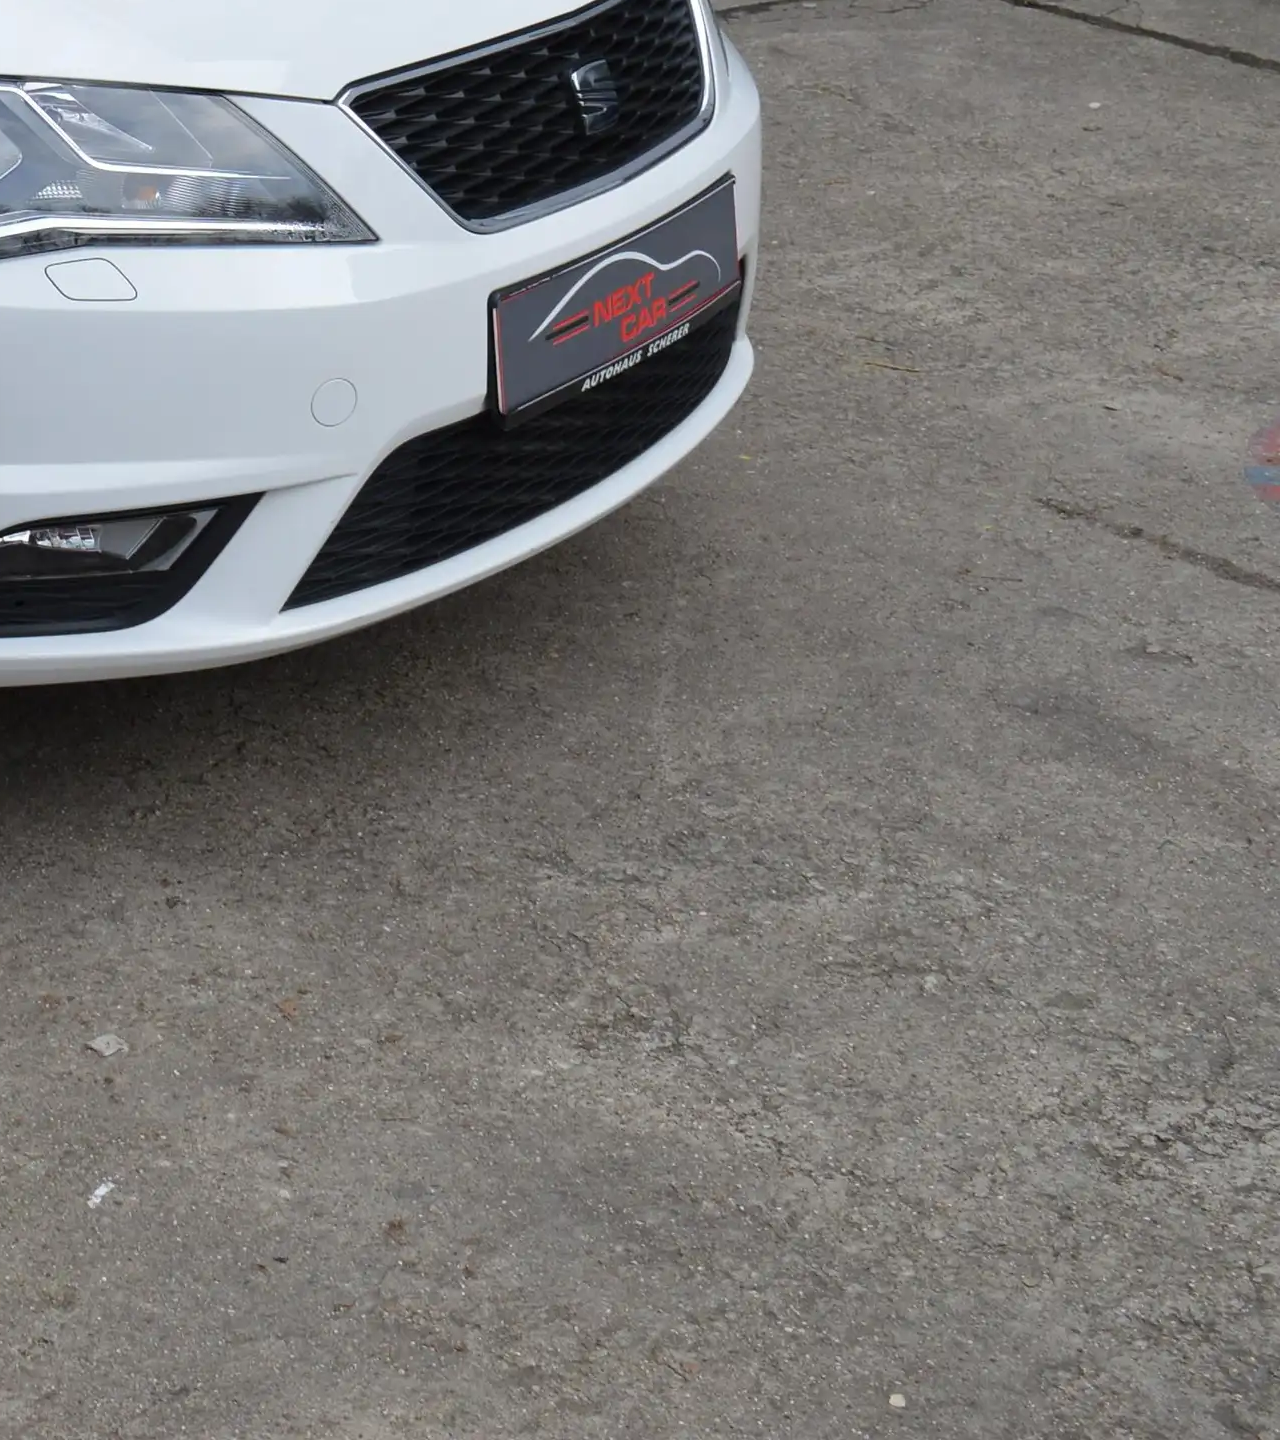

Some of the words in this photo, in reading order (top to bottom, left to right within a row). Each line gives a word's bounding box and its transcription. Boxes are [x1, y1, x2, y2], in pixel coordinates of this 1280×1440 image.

[592, 272, 657, 328] NEXT
[619, 297, 669, 343] CAR
[581, 350, 643, 392] AUTOHAUS
[647, 323, 690, 357] SCHERER
